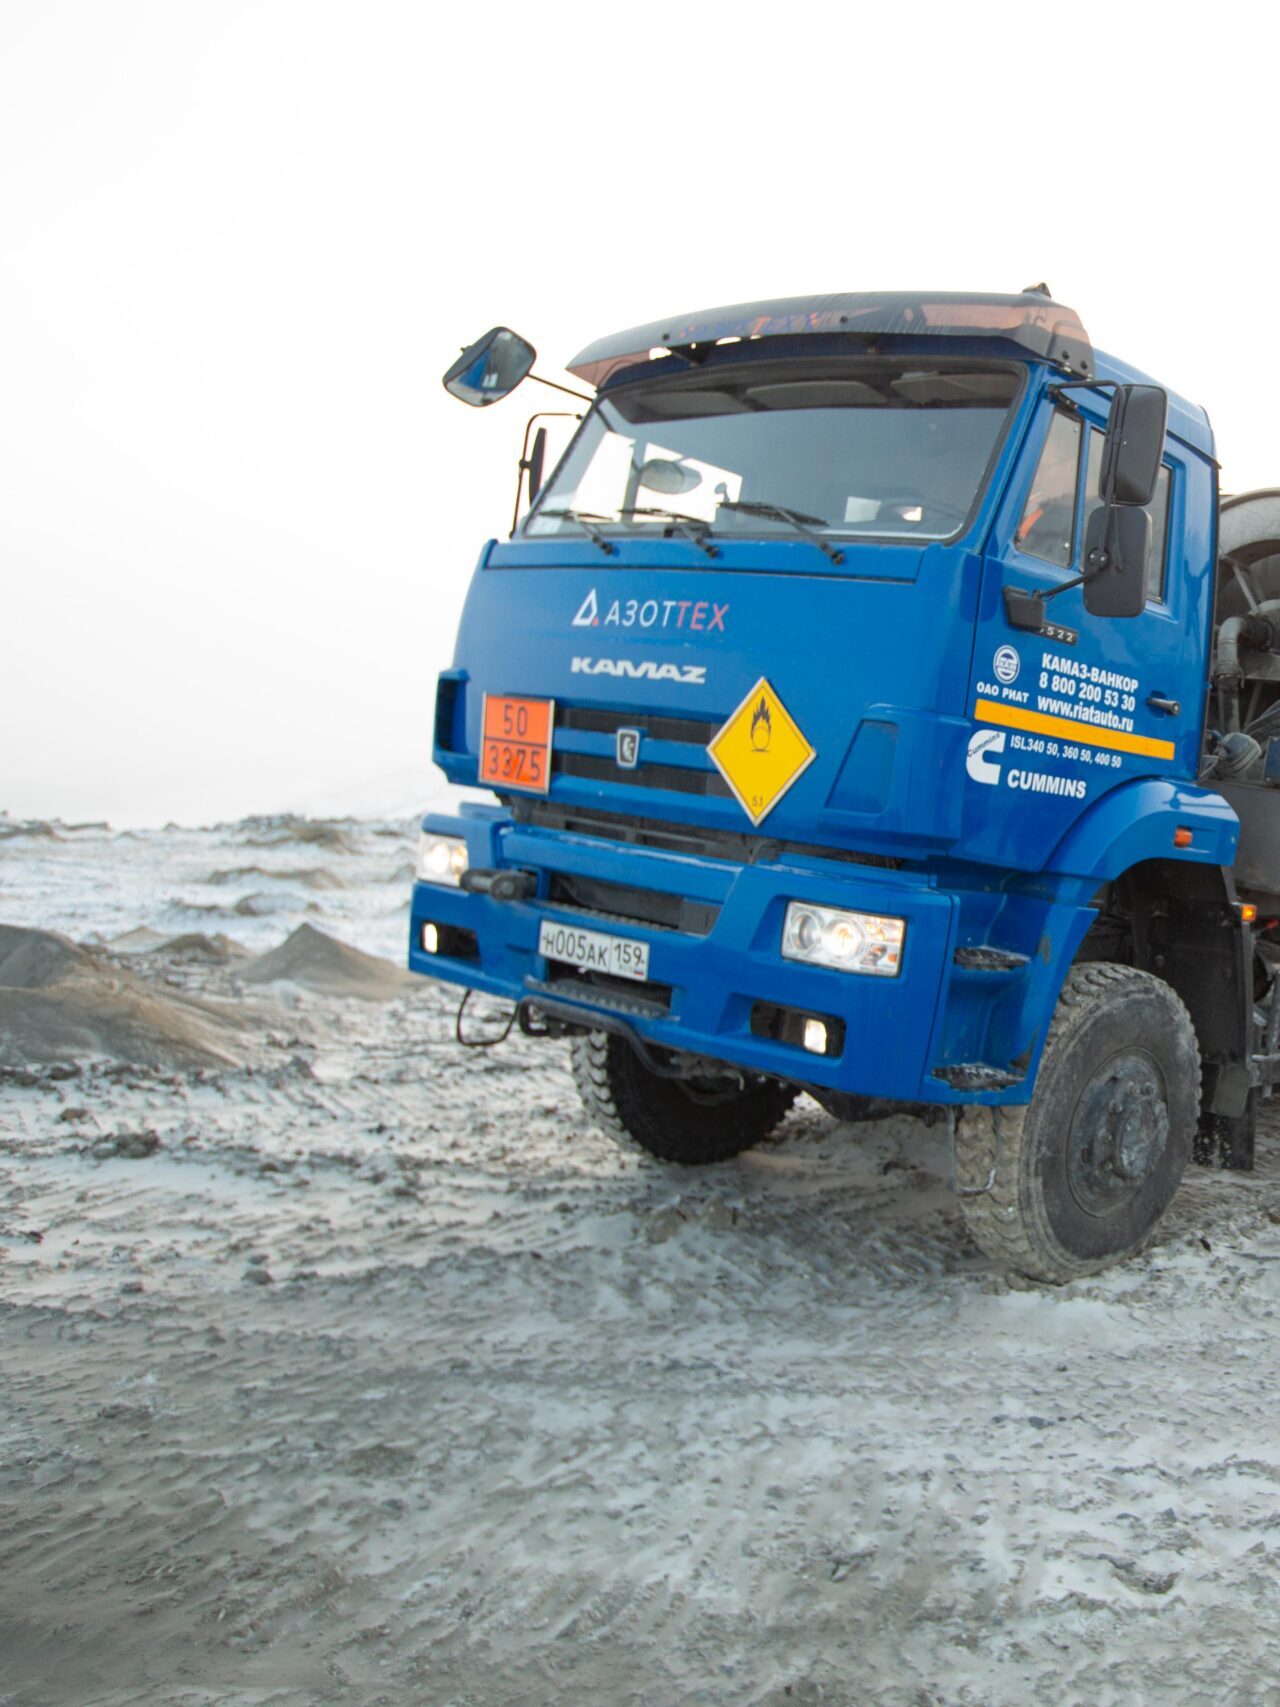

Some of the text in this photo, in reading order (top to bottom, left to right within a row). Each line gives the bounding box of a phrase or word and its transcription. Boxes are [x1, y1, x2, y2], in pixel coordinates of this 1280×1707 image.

[604, 599, 730, 632] АЗОТТЕХ
[571, 656, 707, 684] KAMAZ
[1042, 652, 1139, 694] КАМАЗ-ВАНКОР
[976, 681, 1029, 704] ОАО РИАТ
[1039, 671, 1136, 712] 8 800 200 53 30
[504, 703, 528, 737] 50
[1037, 695, 1134, 732] www.riatauto.ru
[488, 744, 541, 782] 3375
[1010, 734, 1122, 769] ISL340 50, 360 50, 400 50
[1007, 768, 1087, 799] CUMMINS
[613, 942, 644, 967] 159
